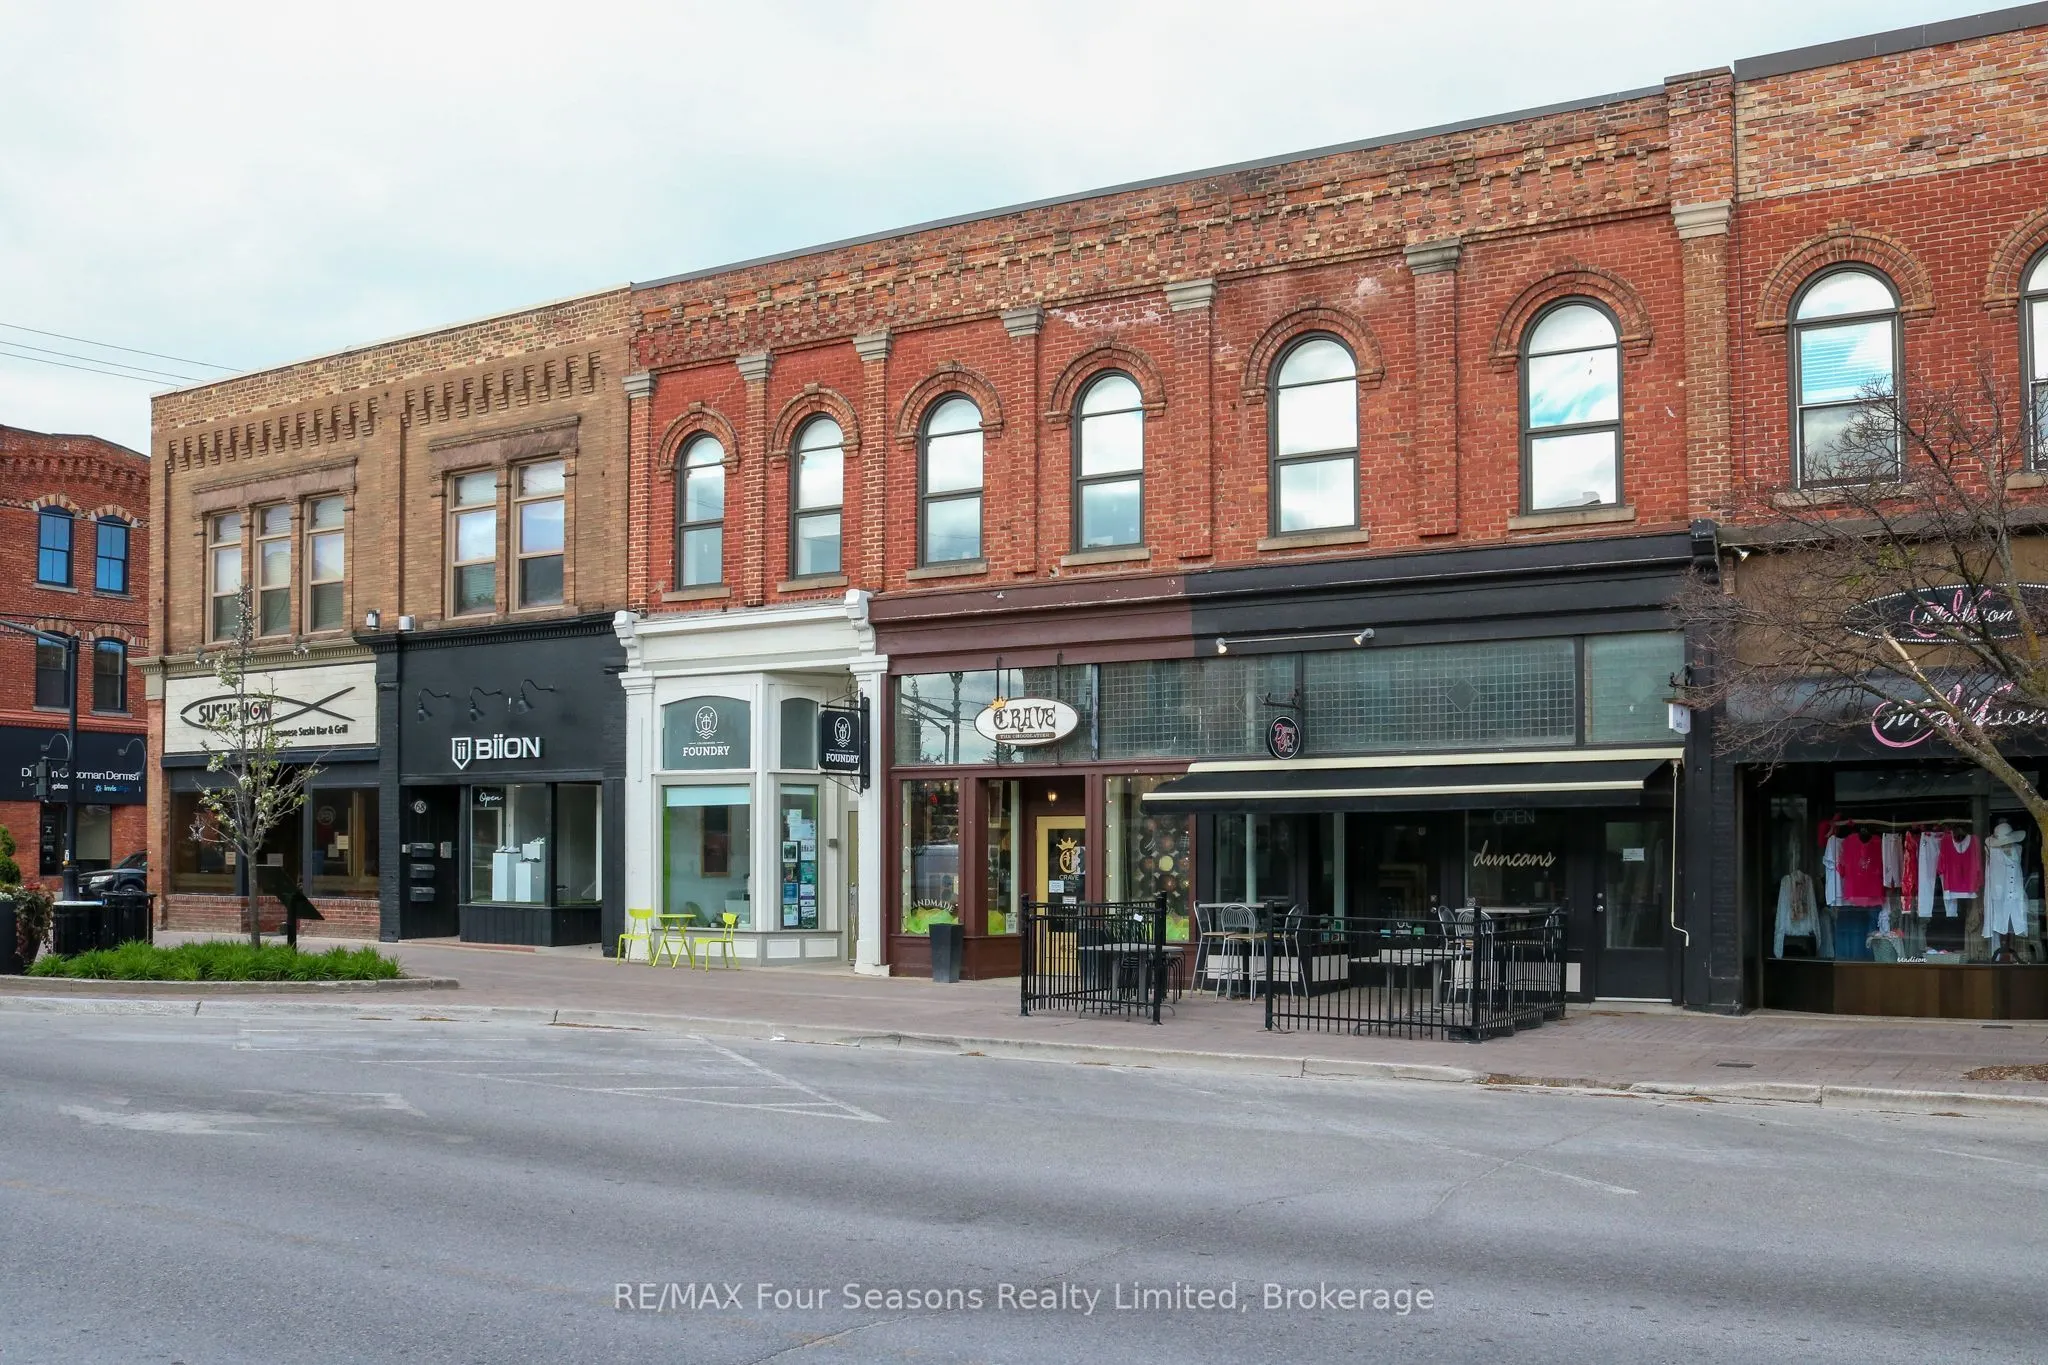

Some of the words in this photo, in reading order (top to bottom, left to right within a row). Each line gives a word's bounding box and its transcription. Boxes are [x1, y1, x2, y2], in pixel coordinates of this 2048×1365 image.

[993, 705, 1056, 733] CRAVE
[298, 726, 315, 736] Sushi
[328, 724, 334, 735] &
[335, 723, 349, 734] Grill
[682, 745, 730, 757] FOUNDRY
[825, 752, 860, 764] FOUNDRY
[479, 792, 504, 807] Open
[1493, 808, 1535, 825] OPEN
[1473, 840, 1556, 868] duncans
[911, 898, 955, 912] ANDMADE
